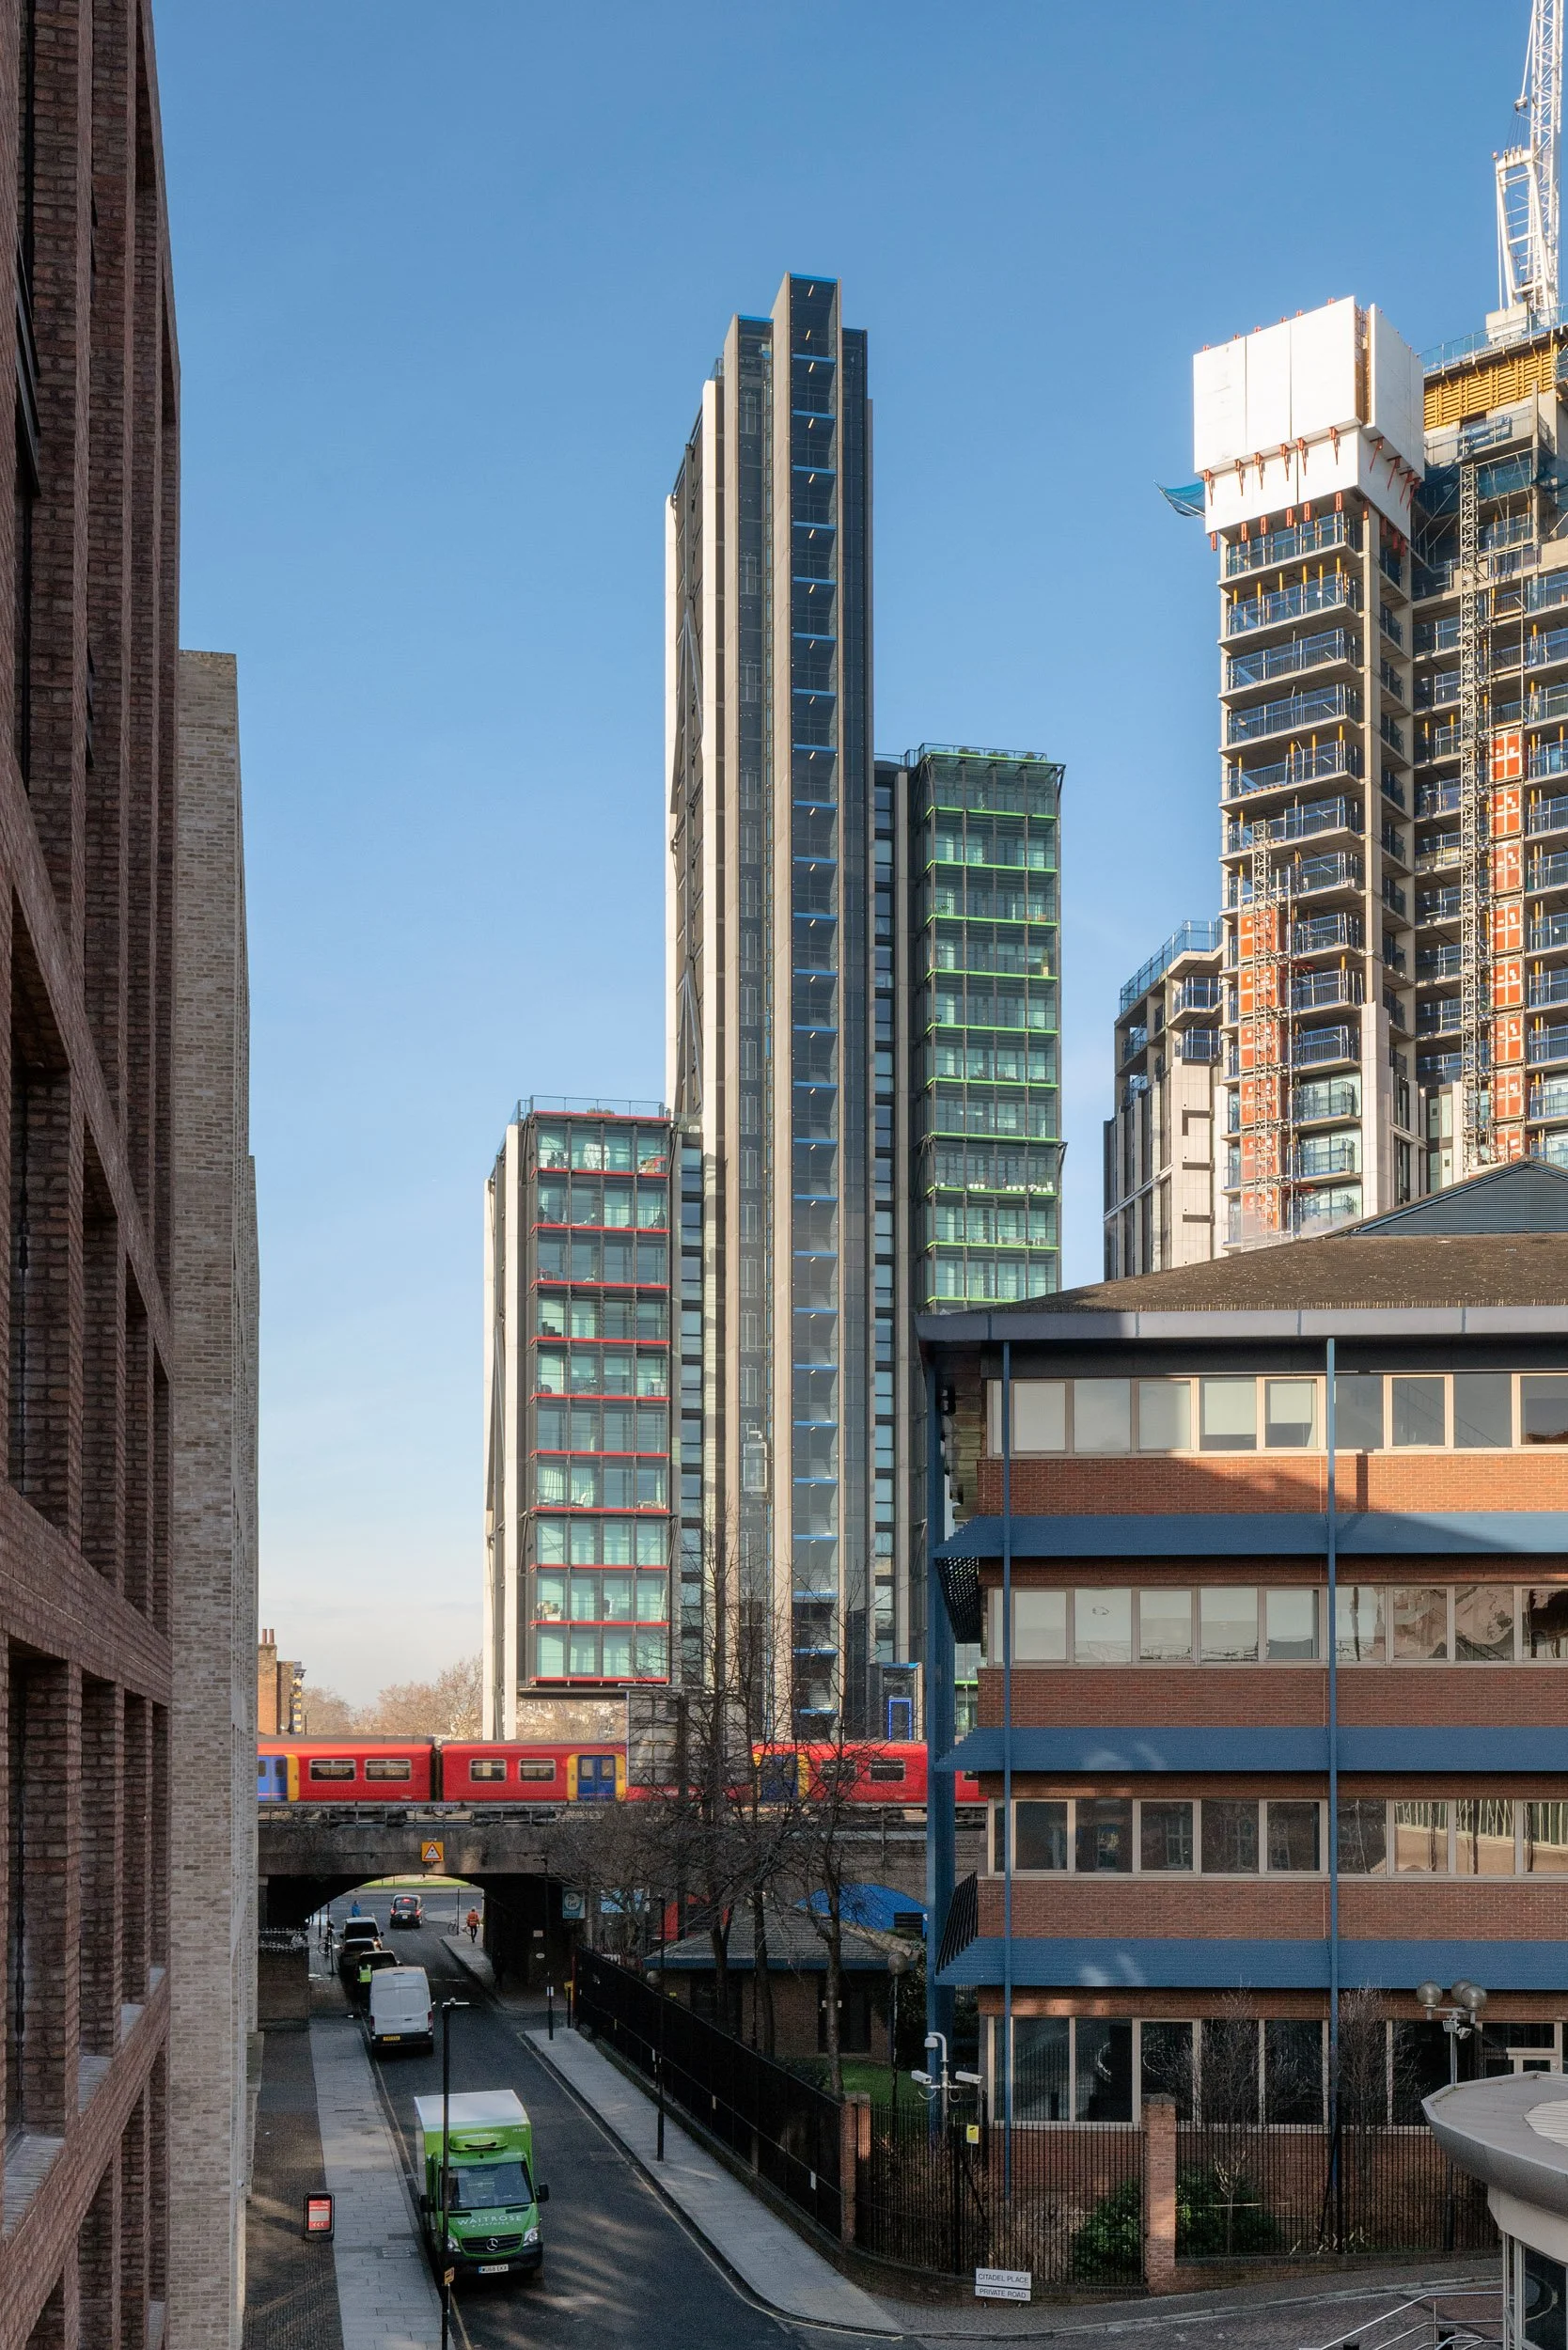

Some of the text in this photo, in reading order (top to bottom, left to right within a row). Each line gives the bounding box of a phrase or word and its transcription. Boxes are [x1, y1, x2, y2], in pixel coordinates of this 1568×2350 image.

[458, 2215, 522, 2225] WAITROSE
[978, 2273, 1005, 2281] CITADEL
[979, 2288, 1006, 2296] PRIVATE
